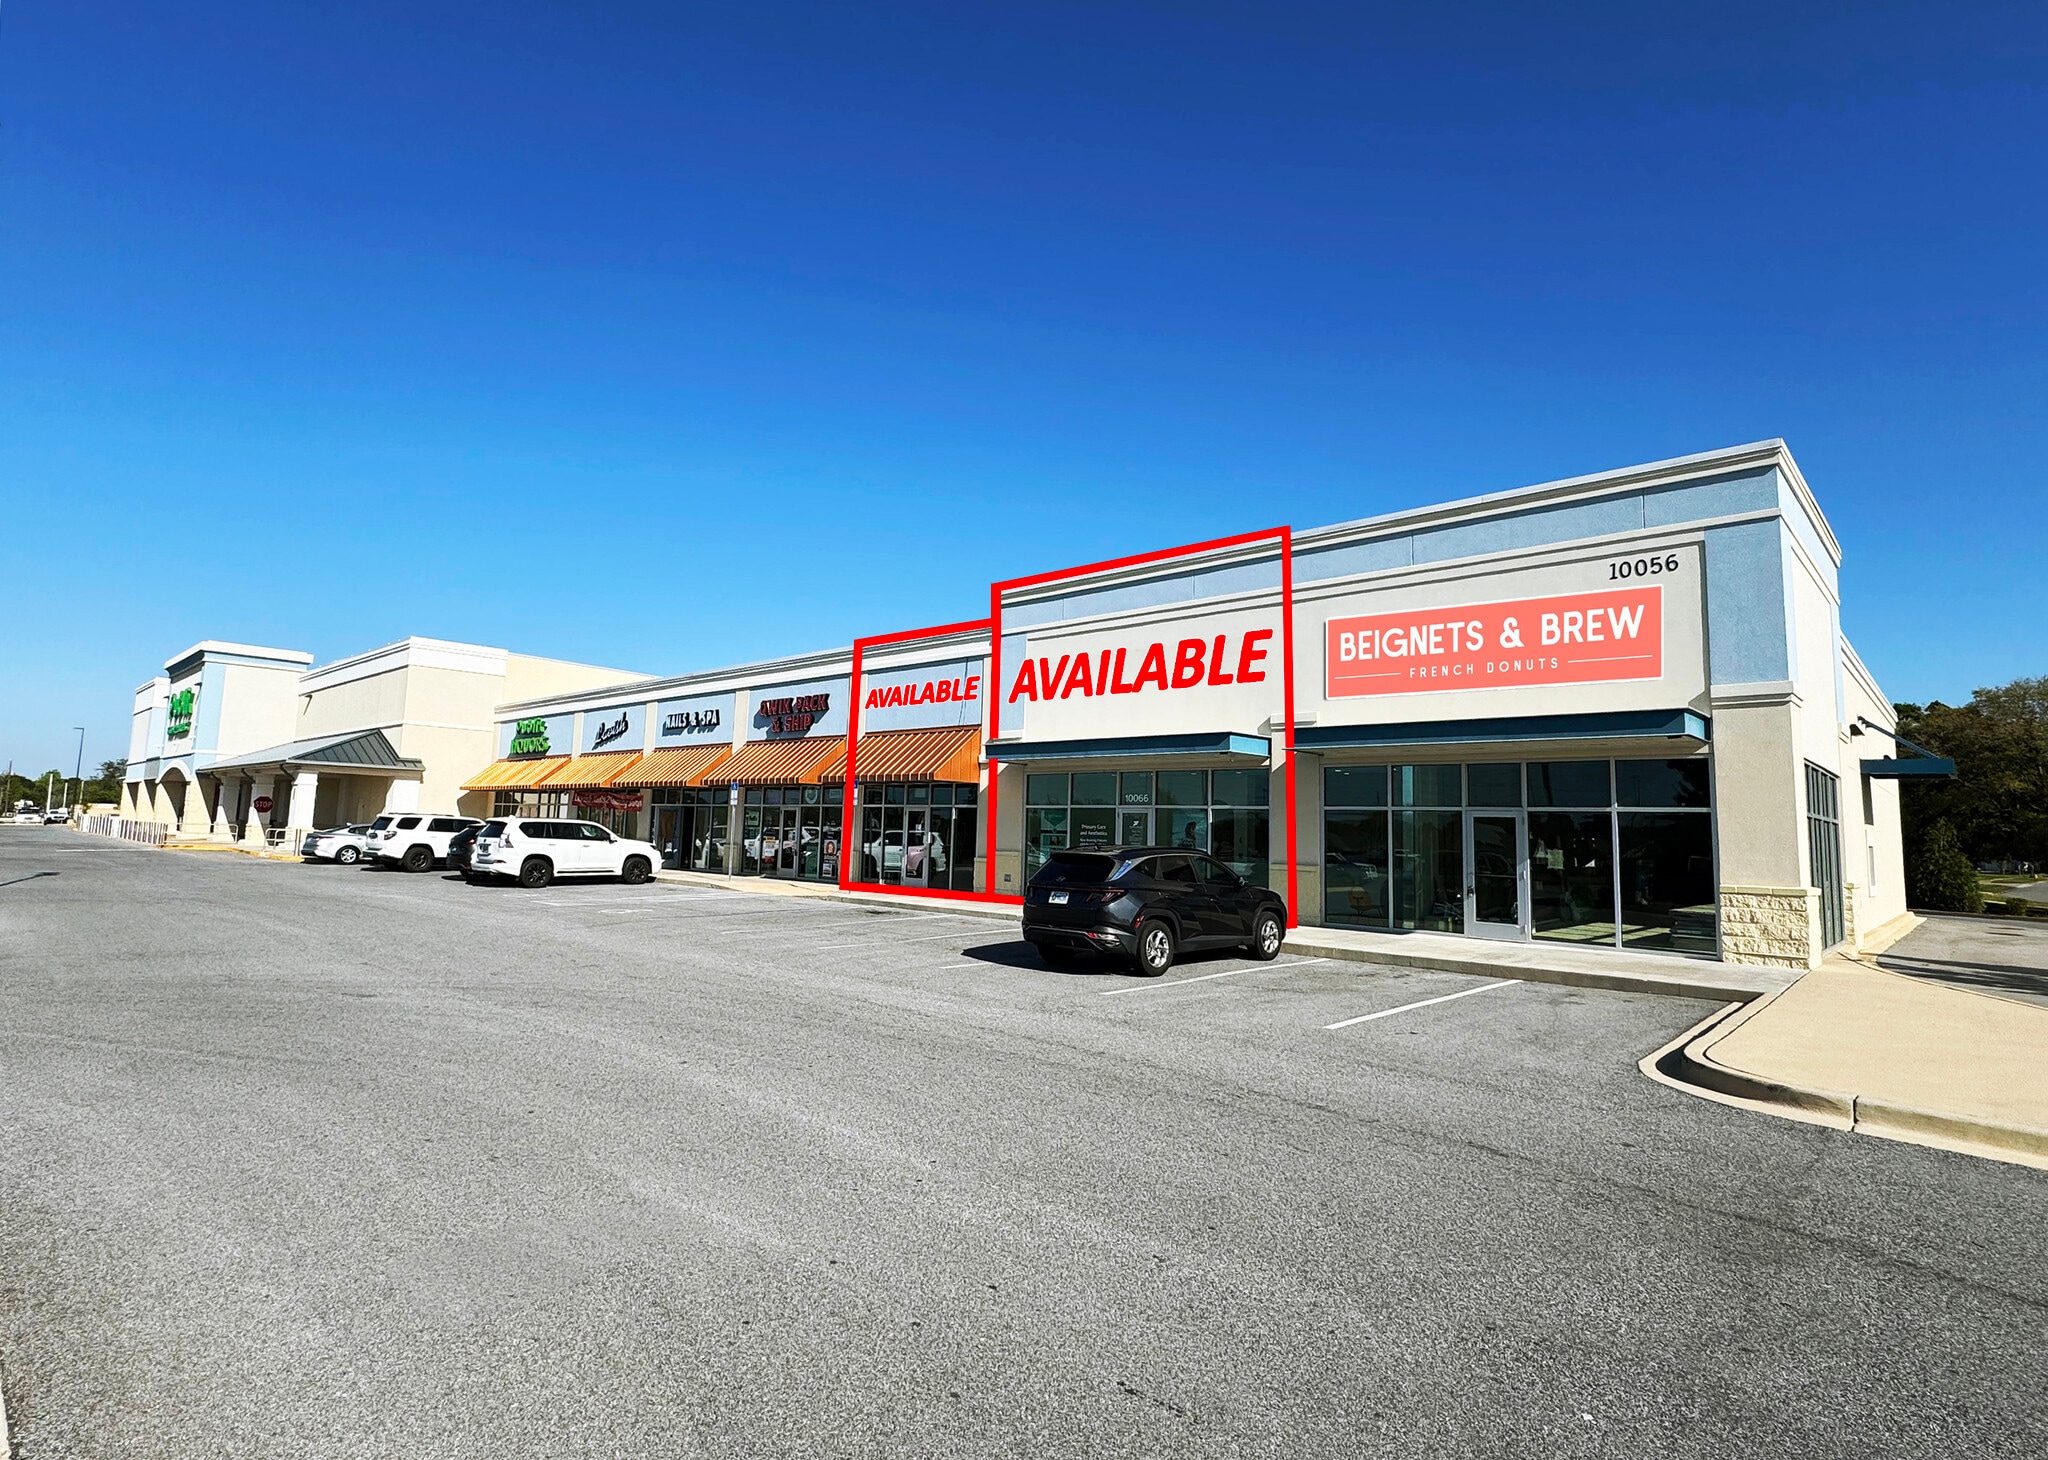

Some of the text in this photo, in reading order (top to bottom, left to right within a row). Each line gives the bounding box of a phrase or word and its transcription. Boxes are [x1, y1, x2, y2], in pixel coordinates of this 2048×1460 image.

[1608, 553, 1679, 581] 10056
[1339, 604, 1645, 662] BEIGNETS & BREW
[1409, 657, 1559, 679] FRENCH DONUTS
[760, 694, 828, 715] QWIK PACK
[665, 709, 718, 730] NAILS & SPA
[772, 714, 812, 732] & SHIP
[1125, 793, 1149, 803] 10066
